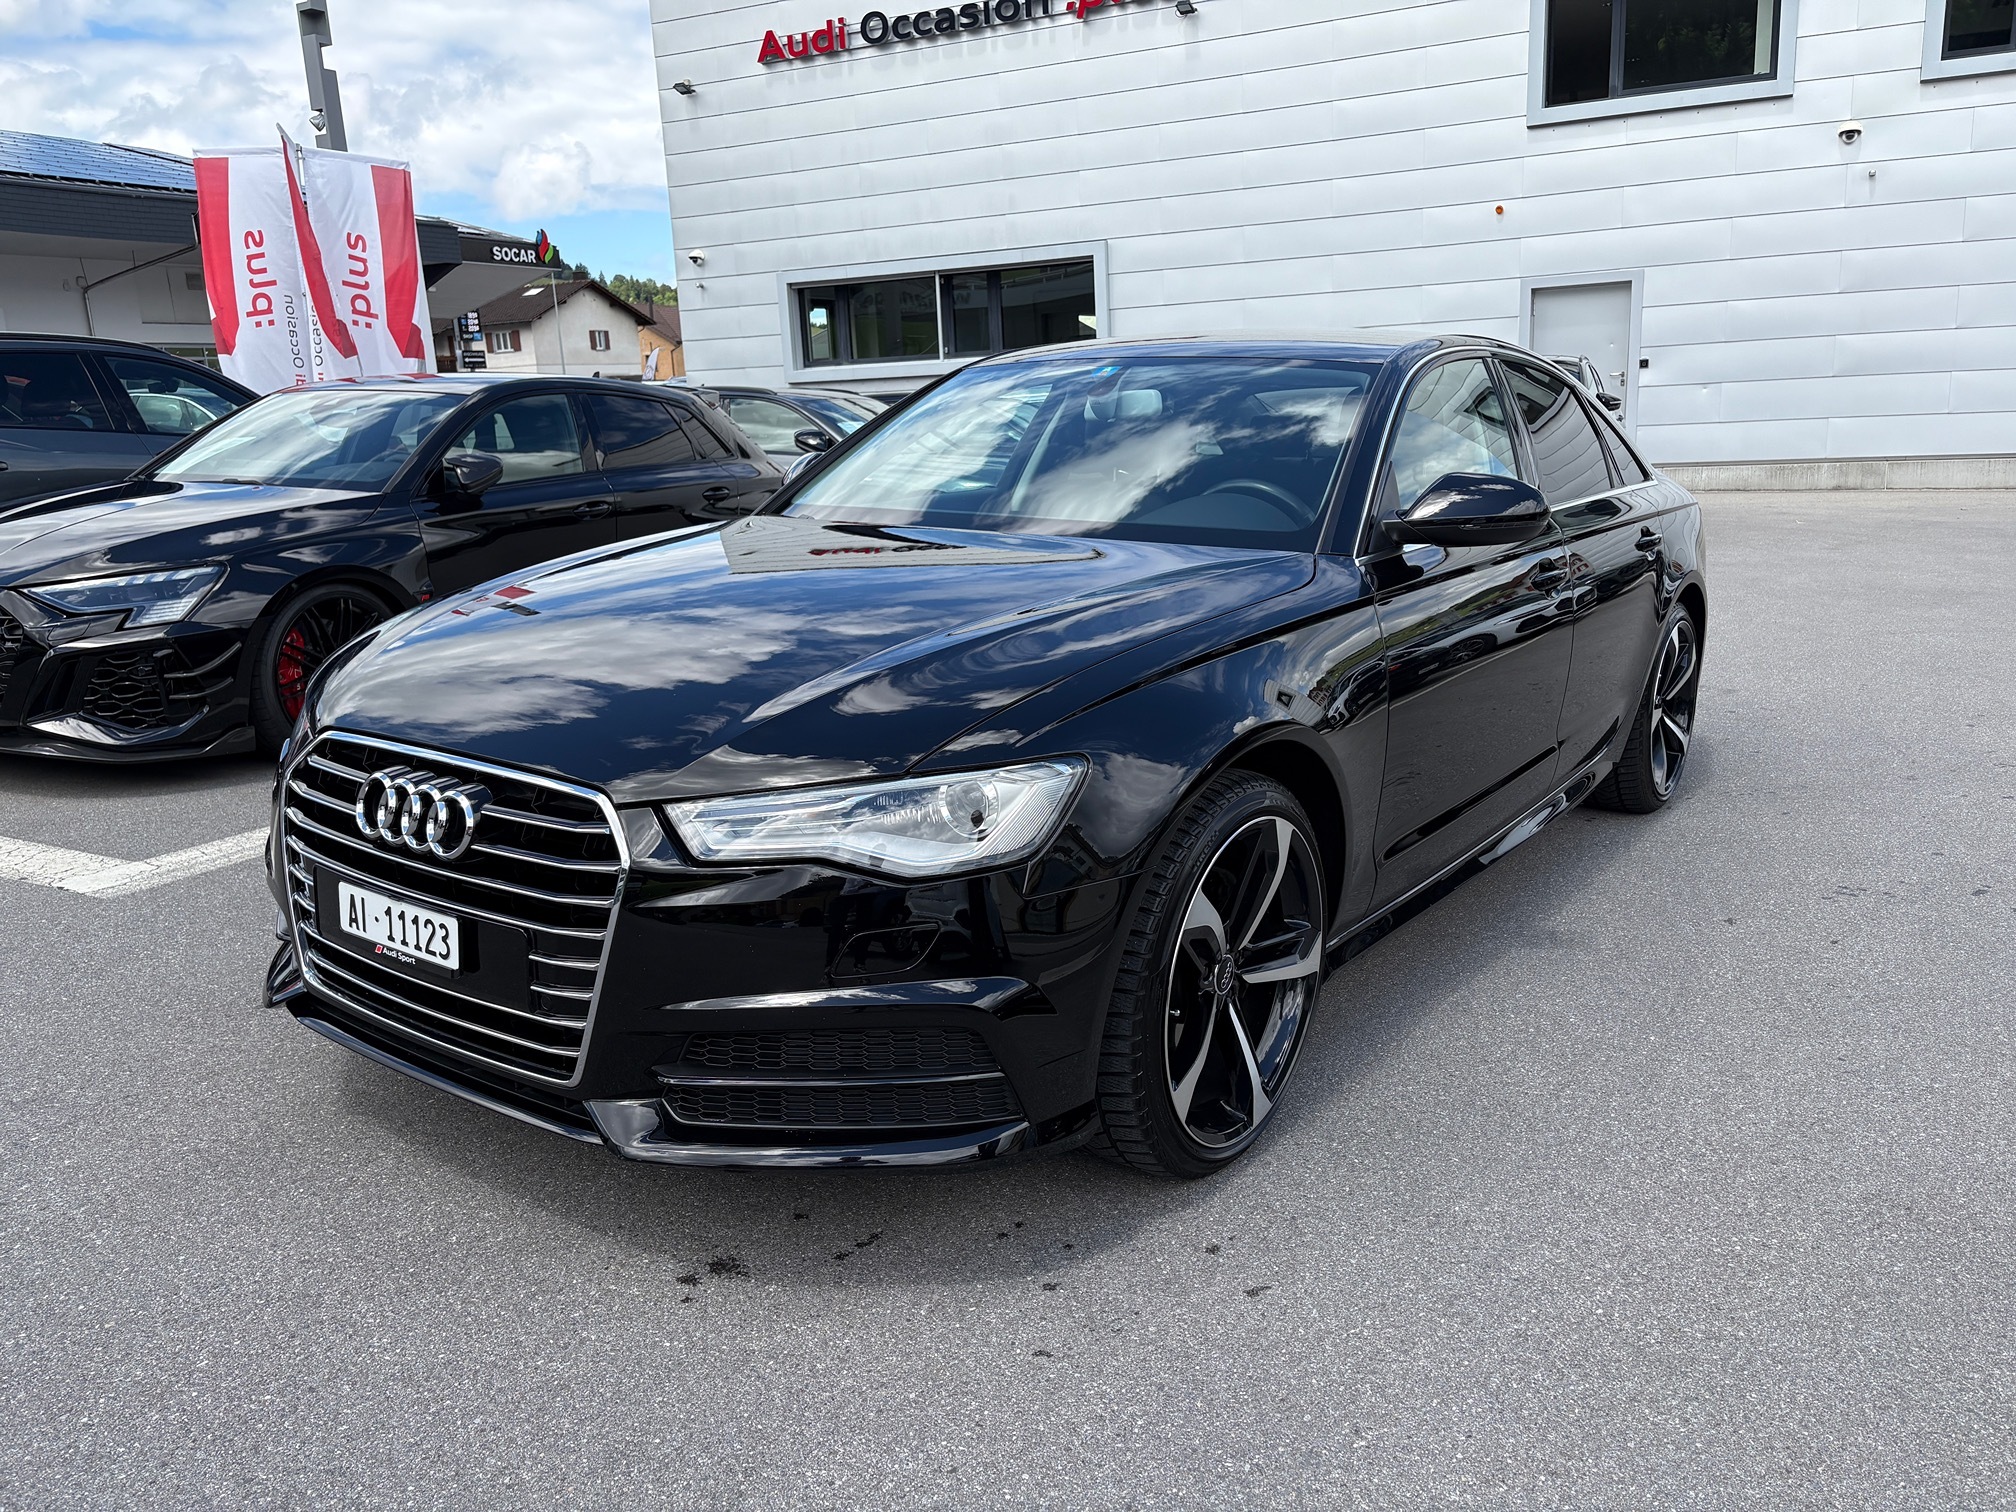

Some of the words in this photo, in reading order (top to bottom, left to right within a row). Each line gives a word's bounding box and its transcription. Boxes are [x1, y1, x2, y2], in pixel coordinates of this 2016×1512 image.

[757, 17, 847, 63] Audi
[860, 0, 1050, 44] Occasion
[492, 245, 537, 264] SOCAR
[383, 946, 398, 959] Audi
[397, 951, 416, 965] Sport
